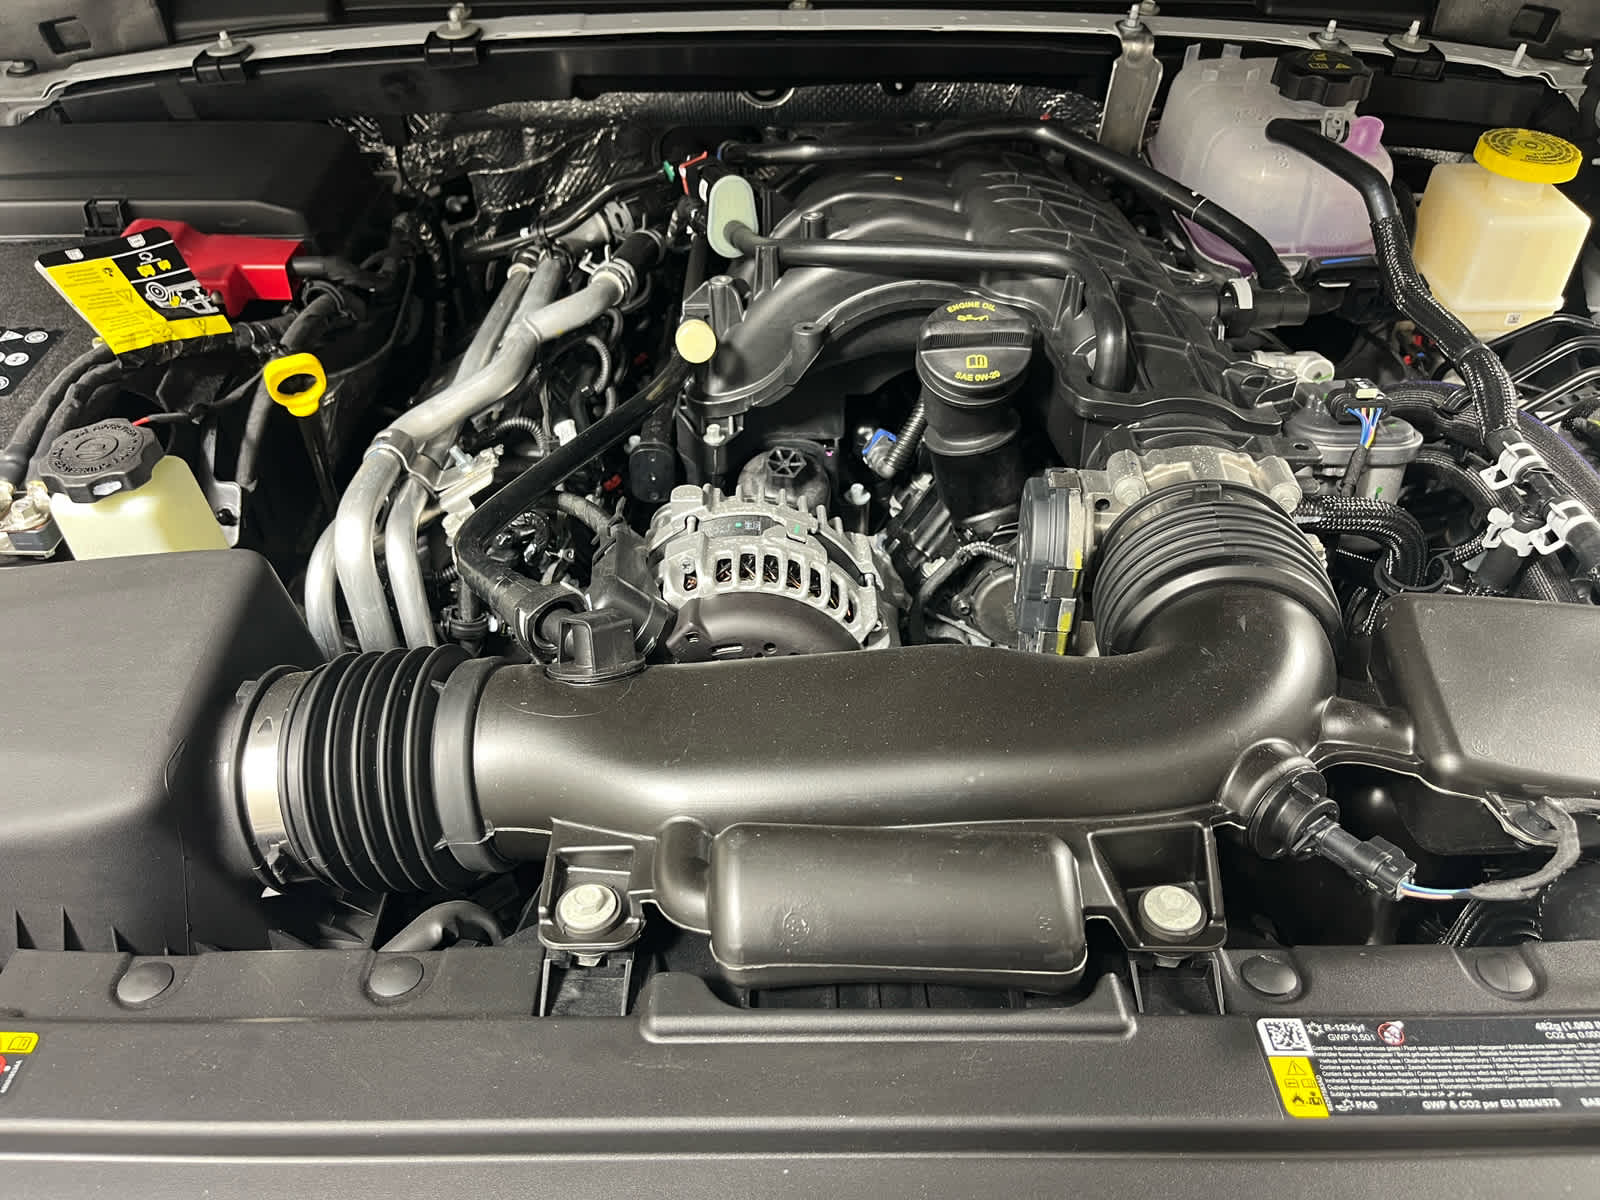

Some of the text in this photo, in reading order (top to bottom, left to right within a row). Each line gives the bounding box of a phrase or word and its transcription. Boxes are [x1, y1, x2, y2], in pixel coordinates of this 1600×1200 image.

[946, 301, 996, 313] ENGINE OIL
[954, 370, 1001, 382] SAE 0W-20
[1327, 1033, 1350, 1042] GWP
[1355, 1100, 1379, 1110] PAG
[1421, 1099, 1447, 1110] GWP
[1458, 1099, 1482, 1109] CO2
